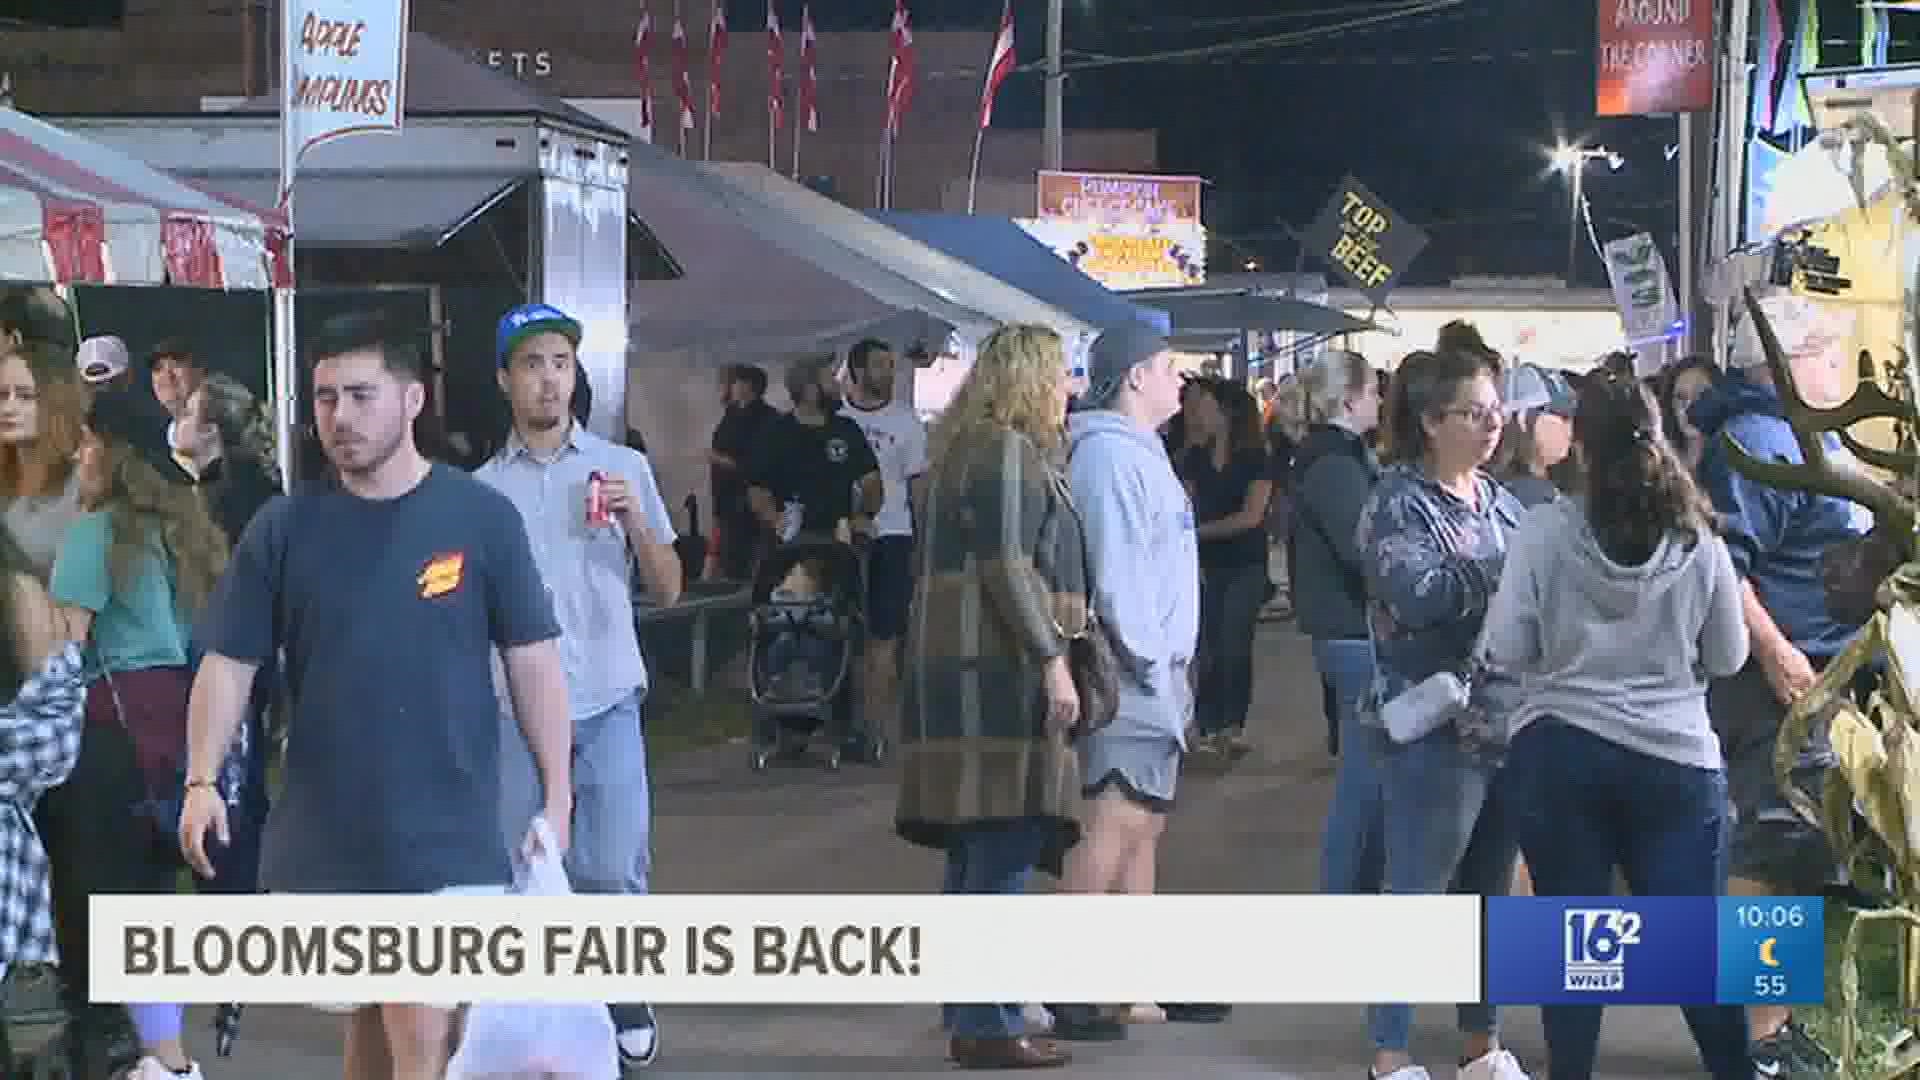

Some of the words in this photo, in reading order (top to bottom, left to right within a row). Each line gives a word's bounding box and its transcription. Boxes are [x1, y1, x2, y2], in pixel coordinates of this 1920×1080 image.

[302, 11, 368, 56] APPLE
[1340, 191, 1386, 233] TOP
[1331, 233, 1392, 288] BEEF
